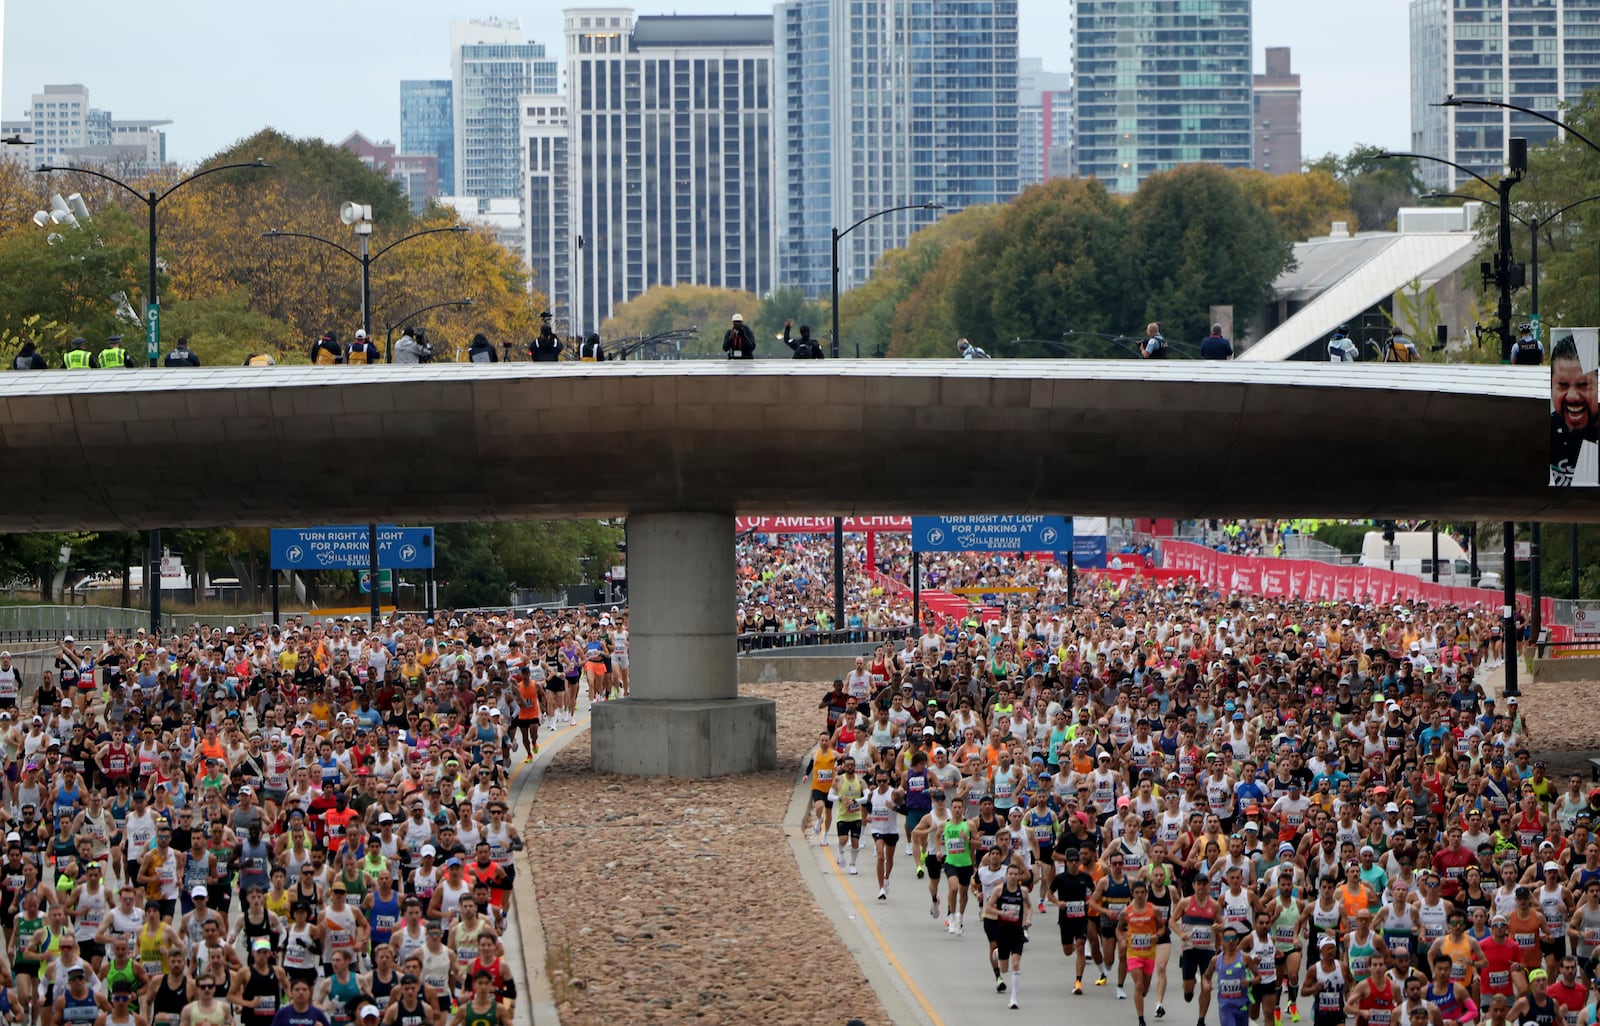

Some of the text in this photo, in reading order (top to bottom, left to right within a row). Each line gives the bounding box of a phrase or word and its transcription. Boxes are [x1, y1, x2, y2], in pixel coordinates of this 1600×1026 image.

[774, 516, 856, 527] AMERIA
[940, 514, 1045, 524] TURN RIGHT AT LIGHT
[951, 524, 1034, 533] FOR PARKING AT
[299, 532, 326, 541] TURN
[328, 532, 358, 541] RIGHT
[969, 536, 1021, 544] MILLENNIUM
[310, 541, 392, 550] FOR PARKIN AT
